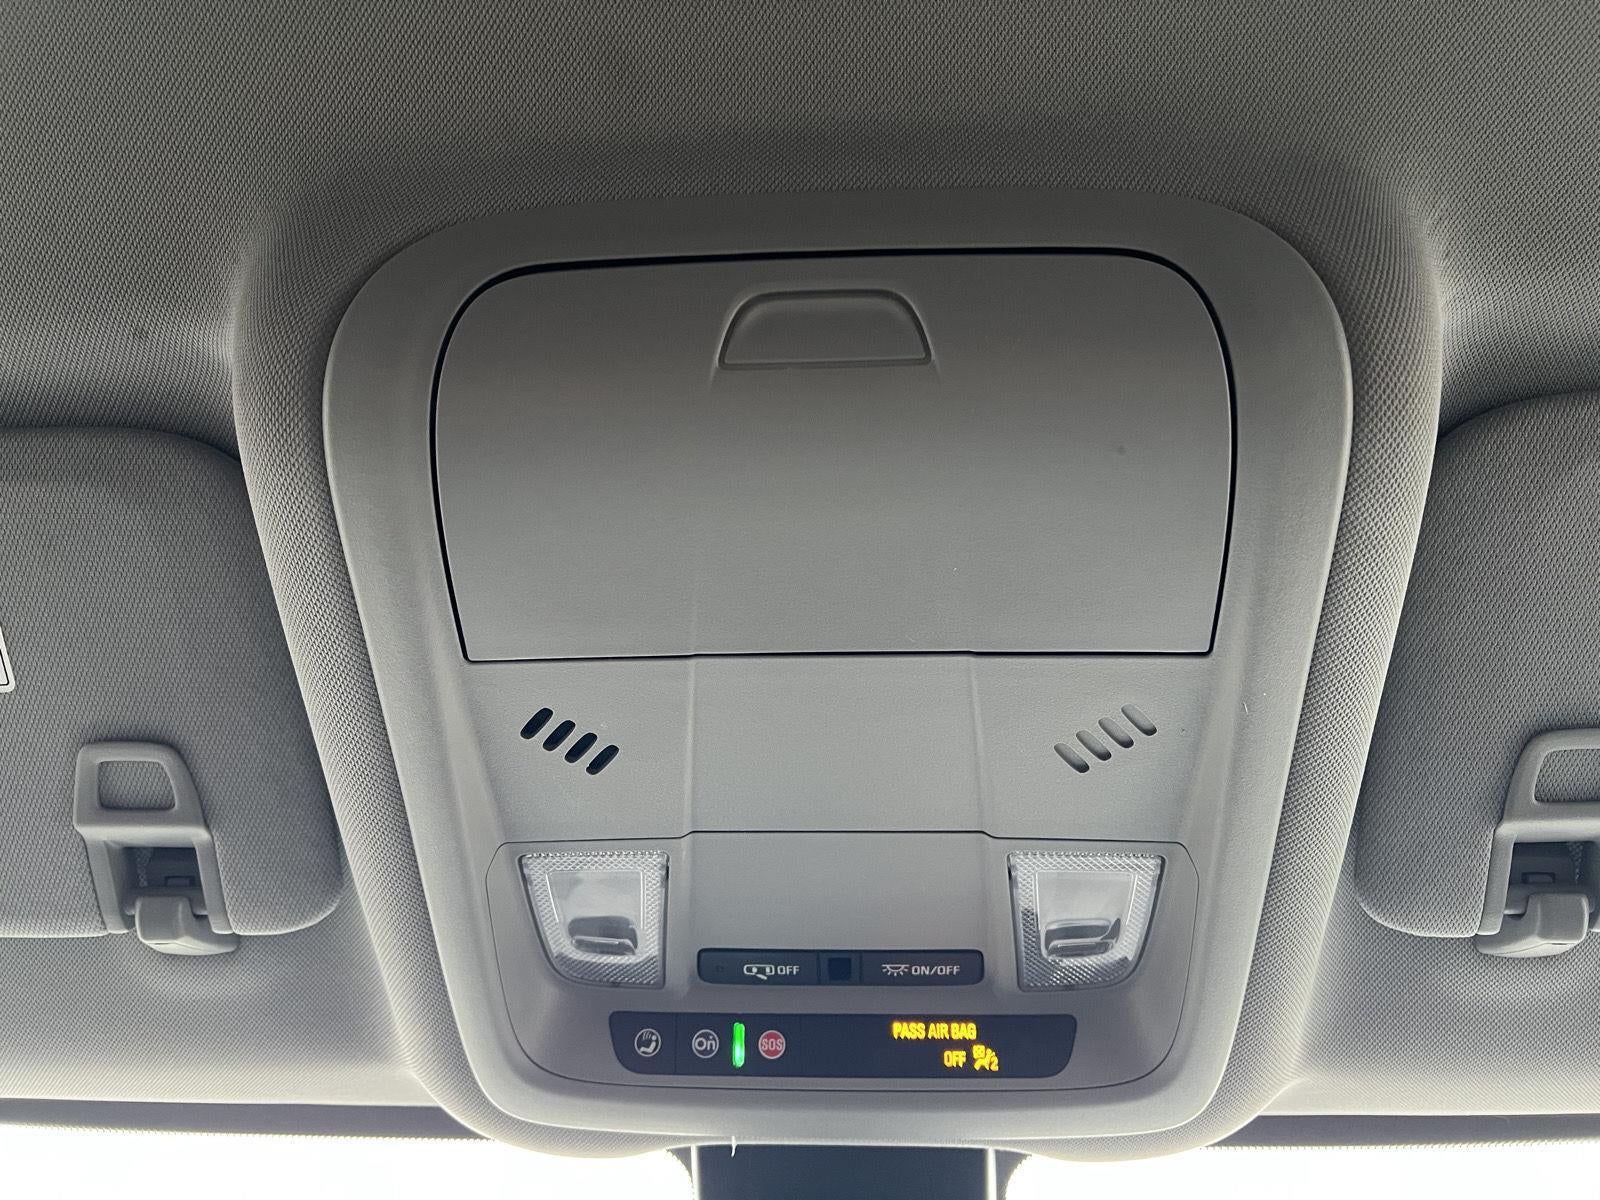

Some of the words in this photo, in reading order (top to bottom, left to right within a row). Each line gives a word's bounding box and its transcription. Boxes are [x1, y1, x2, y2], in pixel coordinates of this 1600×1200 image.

[777, 965, 800, 976] OFF
[911, 965, 960, 976] ON/OFF
[893, 1021, 926, 1040] PASS
[927, 1022, 950, 1040] AIR
[950, 1022, 977, 1040] BAG
[761, 1038, 783, 1051] SOS
[943, 1050, 967, 1068] OFF
